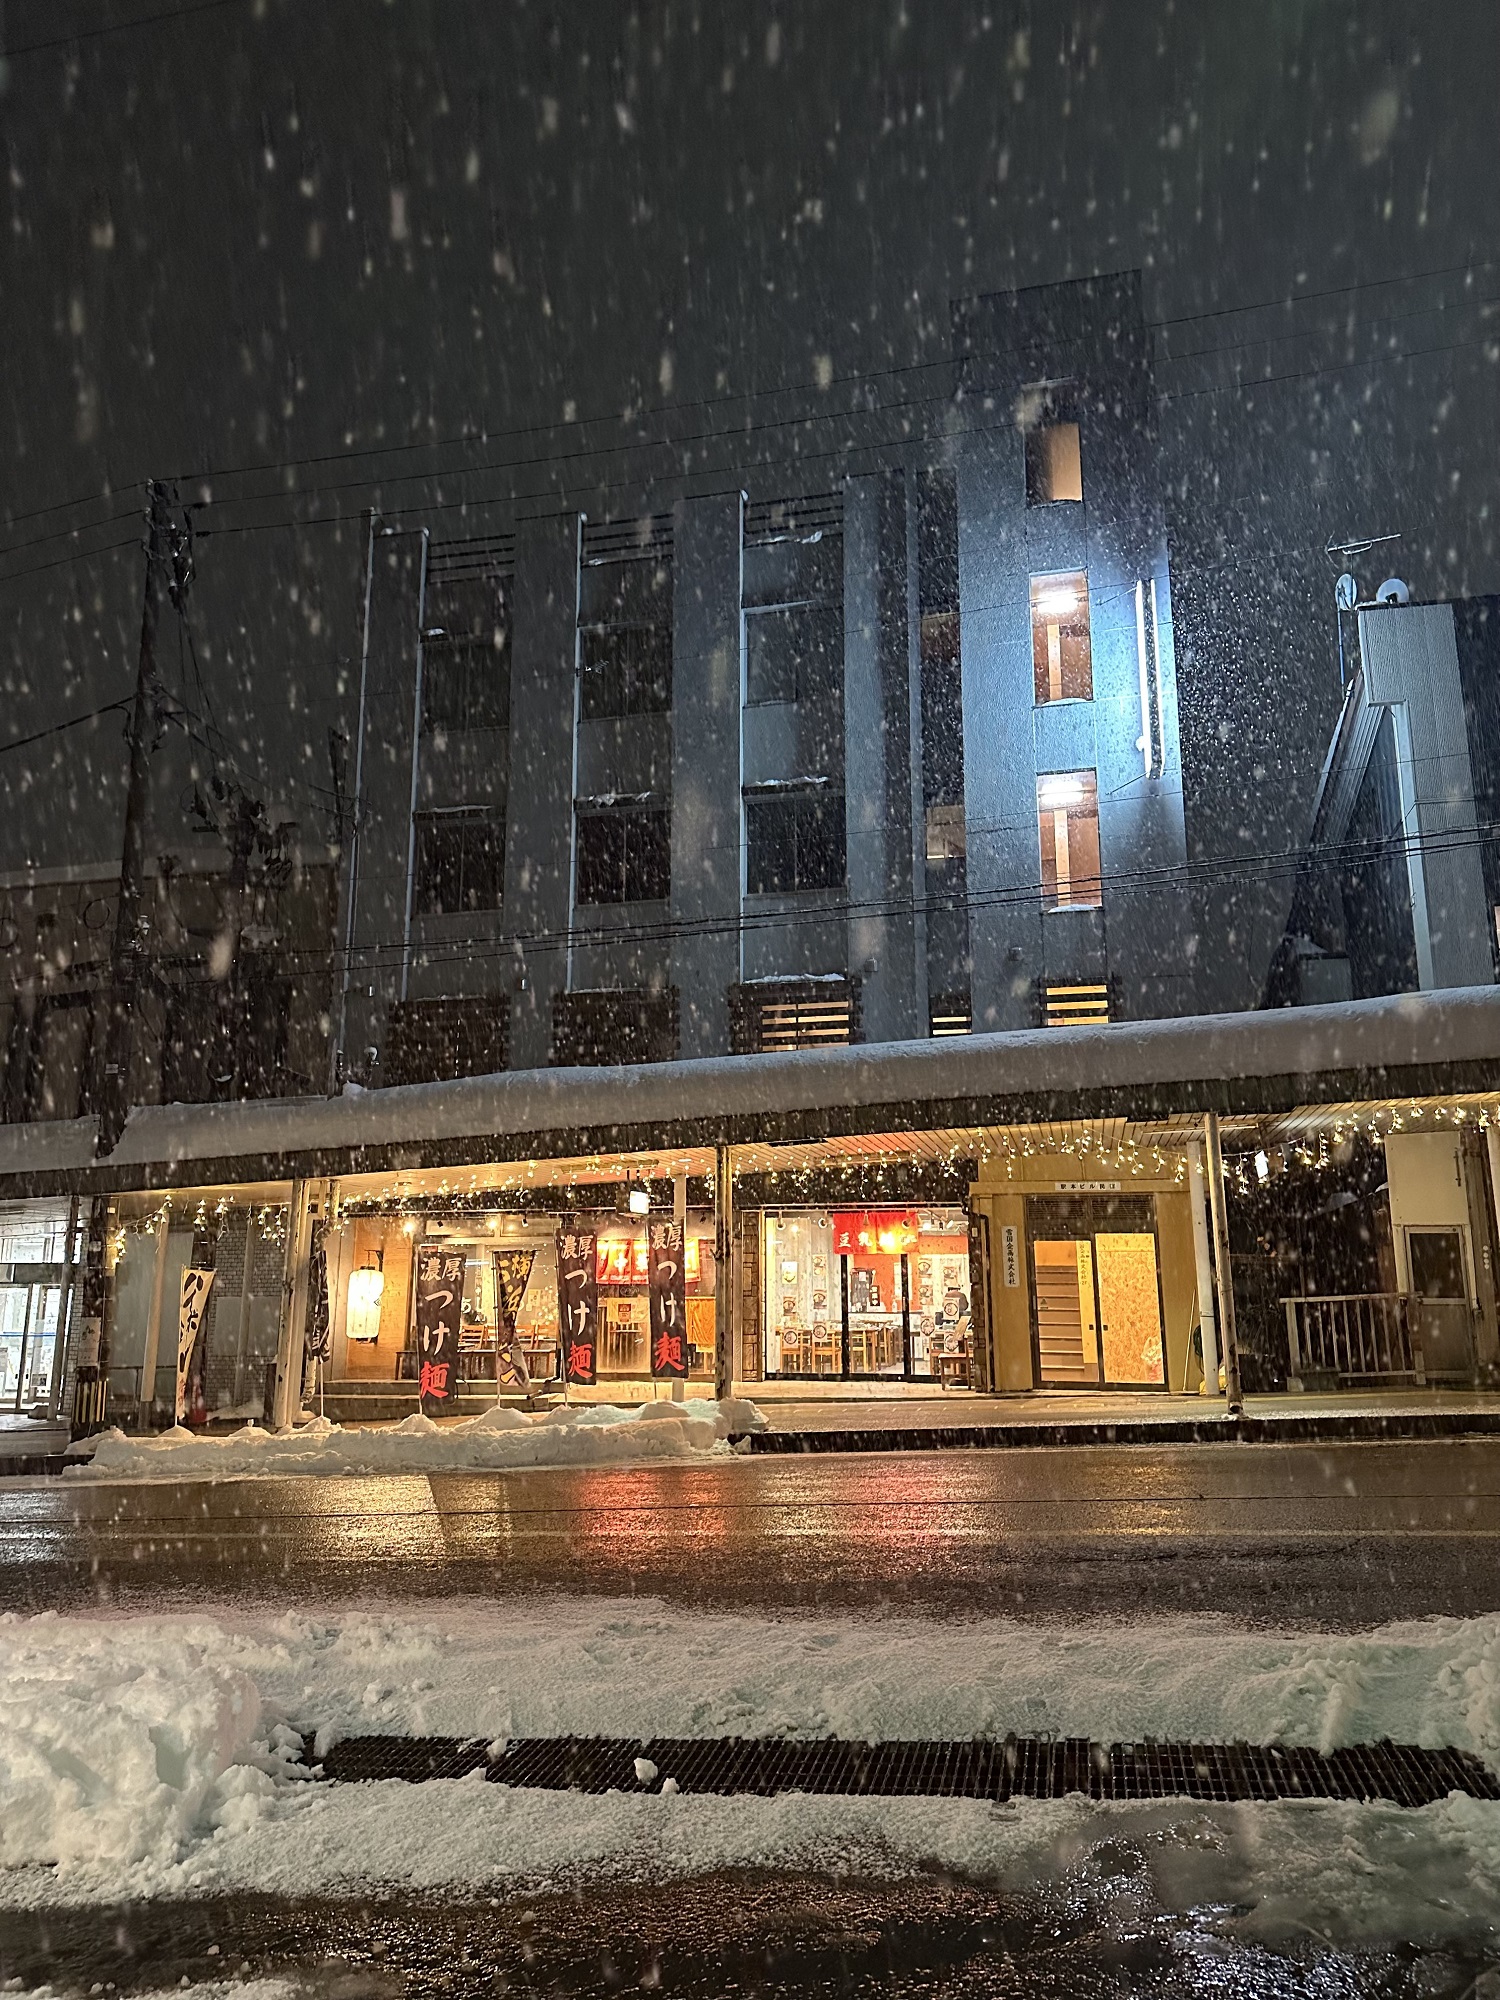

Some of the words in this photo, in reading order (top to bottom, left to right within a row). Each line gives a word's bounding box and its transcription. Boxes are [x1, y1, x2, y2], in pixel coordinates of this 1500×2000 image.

[420, 1257, 462, 1281] 濃厚
[560, 1235, 593, 1260] 濃厚
[651, 1223, 683, 1251] 濃厚
[419, 1290, 454, 1399] つけ麺
[565, 1270, 593, 1378] つけ麺
[654, 1260, 685, 1371] つけ麺
